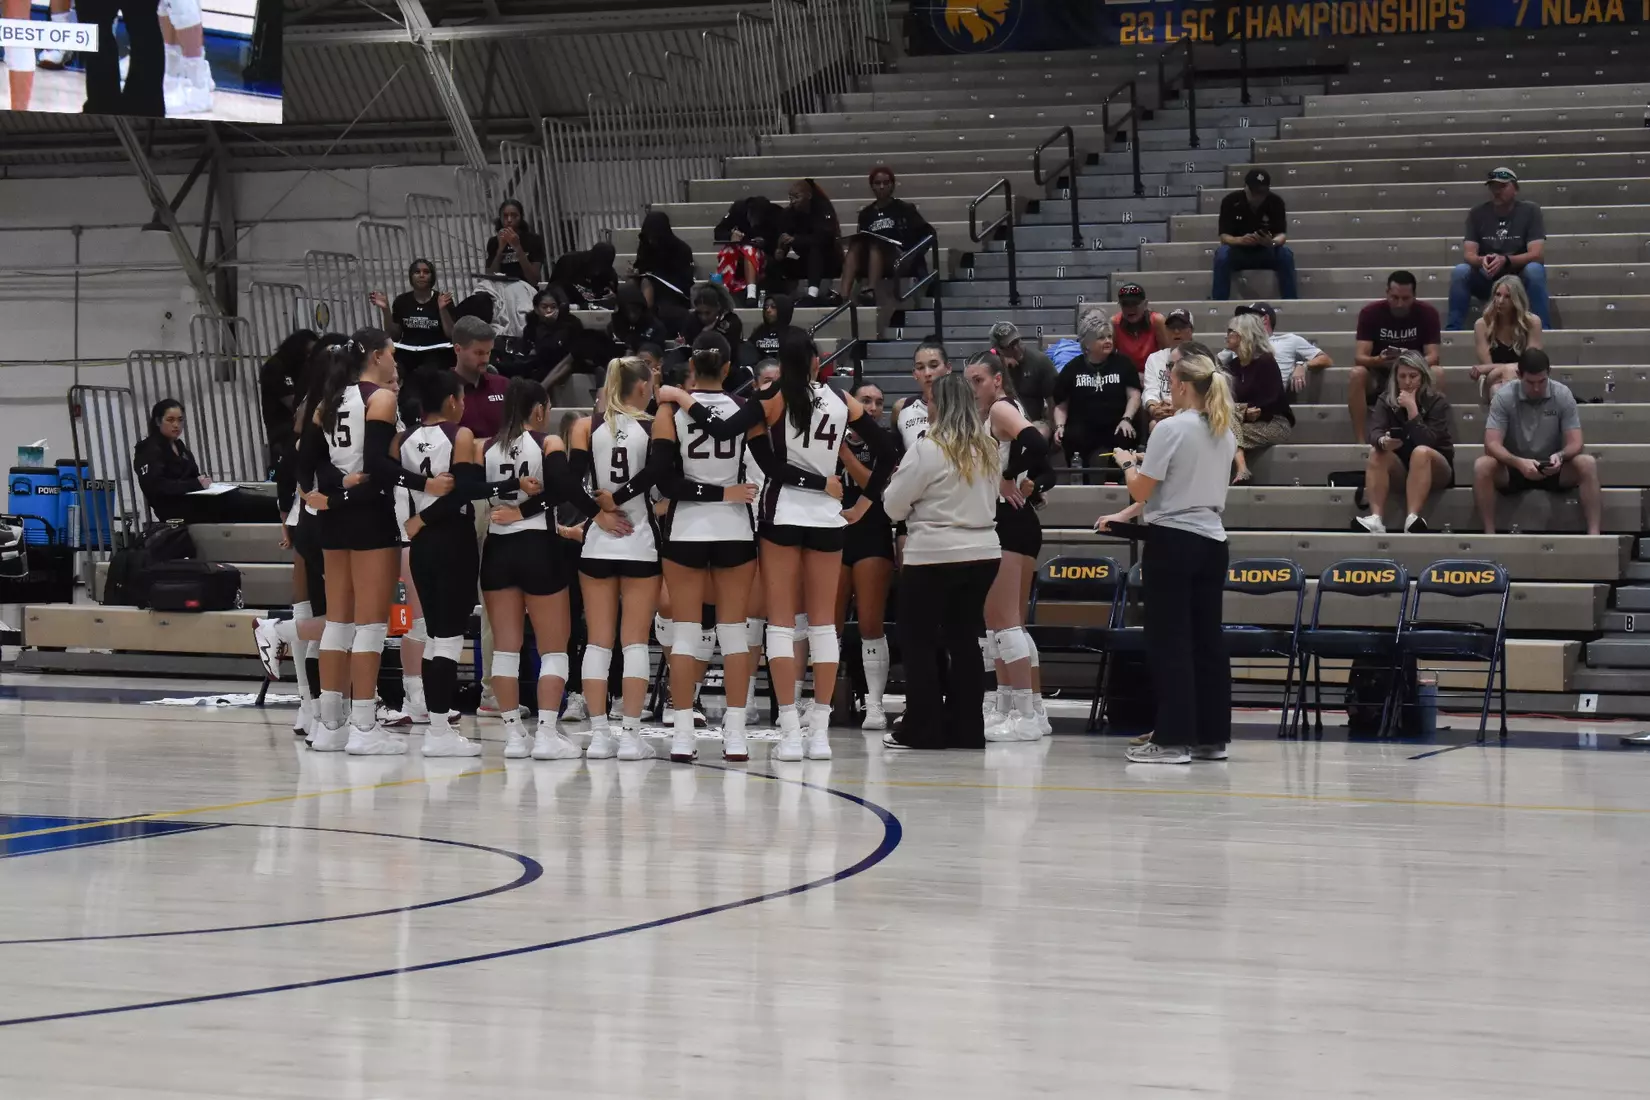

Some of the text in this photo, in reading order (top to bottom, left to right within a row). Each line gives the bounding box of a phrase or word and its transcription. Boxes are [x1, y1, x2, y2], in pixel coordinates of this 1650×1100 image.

[1541, 0, 1625, 26] NCAA
[1120, 0, 1466, 45] 22 LSC CHAMPIONSHIPS
[49, 29, 71, 42] OF
[76, 31, 90, 46] 5)
[1239, 117, 1249, 127] 17
[1216, 138, 1227, 149] 16
[1185, 162, 1196, 173] 15
[1122, 212, 1132, 223] 13
[1092, 238, 1103, 250] 12
[1056, 266, 1066, 278] 11
[1033, 296, 1043, 307] 10
[1380, 327, 1417, 339] SALUKI
[1075, 373, 1120, 387] ARRITON
[905, 416, 929, 430] SOUTHE
[610, 446, 630, 484] 9
[1049, 565, 1109, 579] LIONS
[1229, 568, 1291, 583] LIONS
[1332, 569, 1396, 584] LIONS
[1431, 569, 1495, 584] LIONS
[1625, 614, 1635, 632] B
